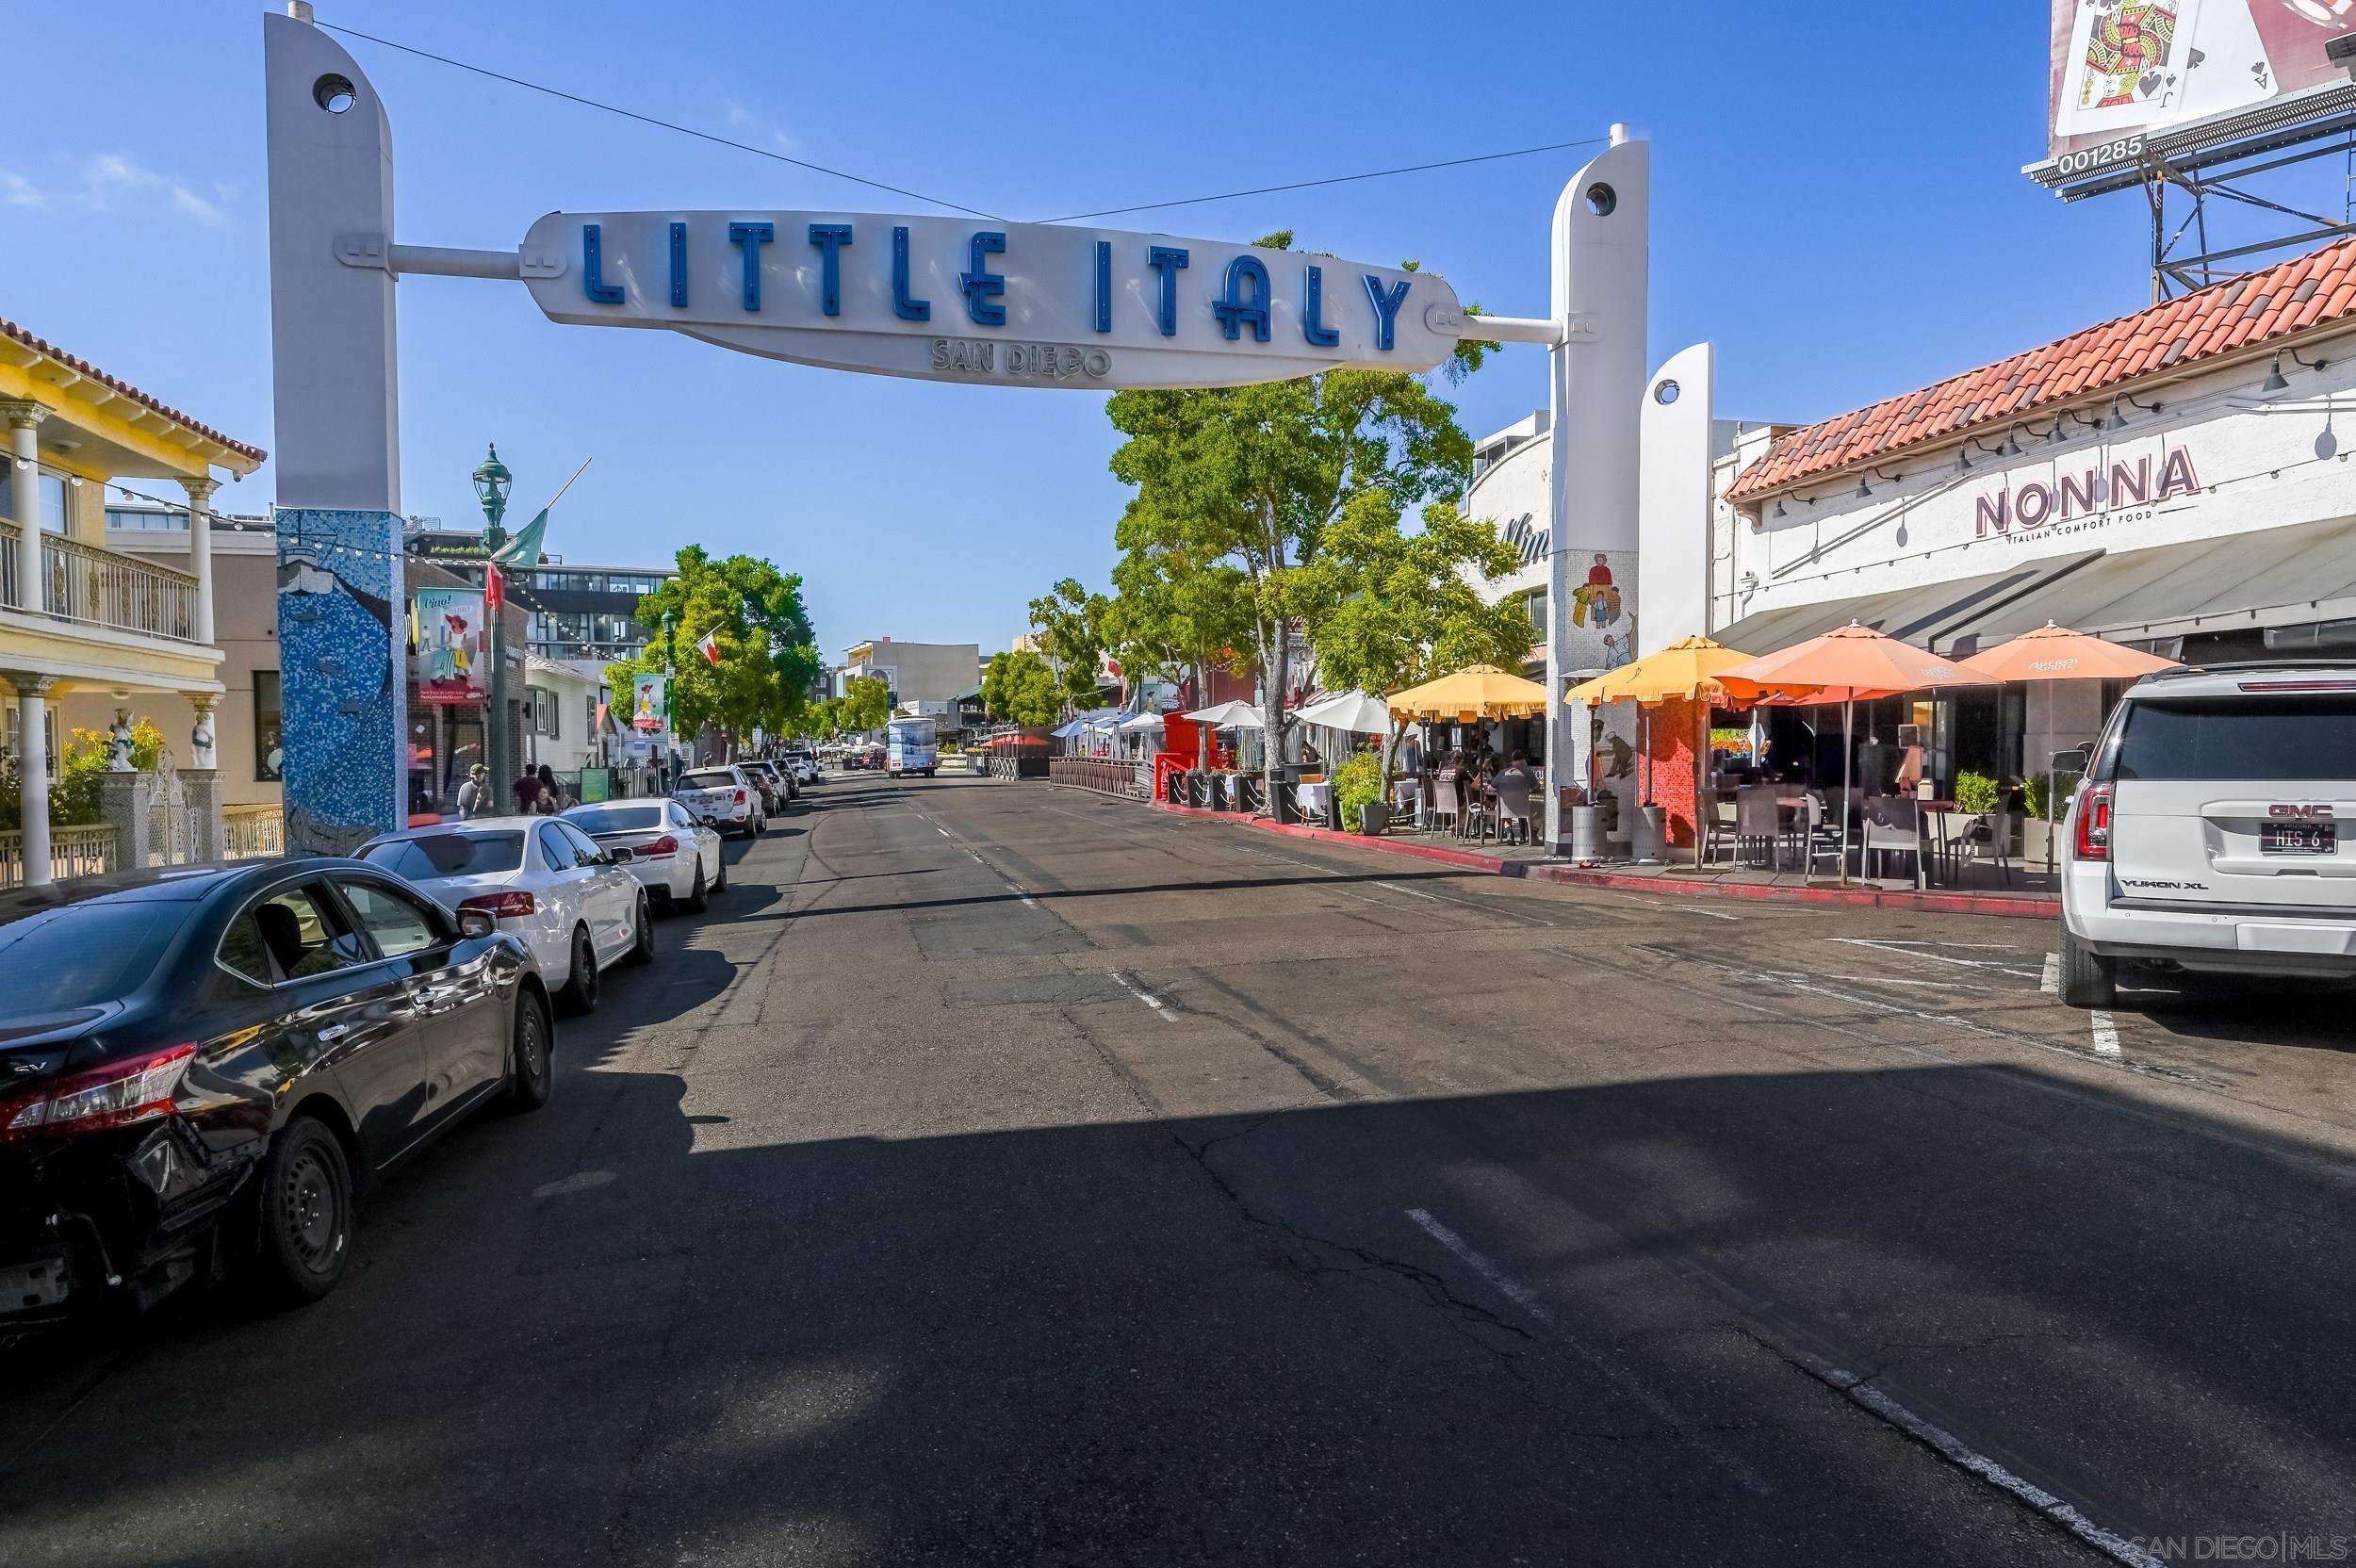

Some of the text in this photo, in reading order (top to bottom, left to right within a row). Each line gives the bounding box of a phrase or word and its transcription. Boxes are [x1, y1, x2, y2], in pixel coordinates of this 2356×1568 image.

[2059, 137, 2142, 174] 001285
[583, 222, 1412, 351] LITTLE ITALY
[932, 339, 1112, 378] SAN DIEGO
[1976, 444, 2201, 537] NONNA
[2057, 518, 2111, 536] COMFORT
[2119, 511, 2151, 524] FOOD
[424, 595, 451, 609] Ciao!
[2027, 657, 2081, 670] APEROL
[2268, 805, 2333, 818] GMC
[2276, 830, 2320, 847] HIS 6
[2120, 879, 2209, 890] YUKON XL
